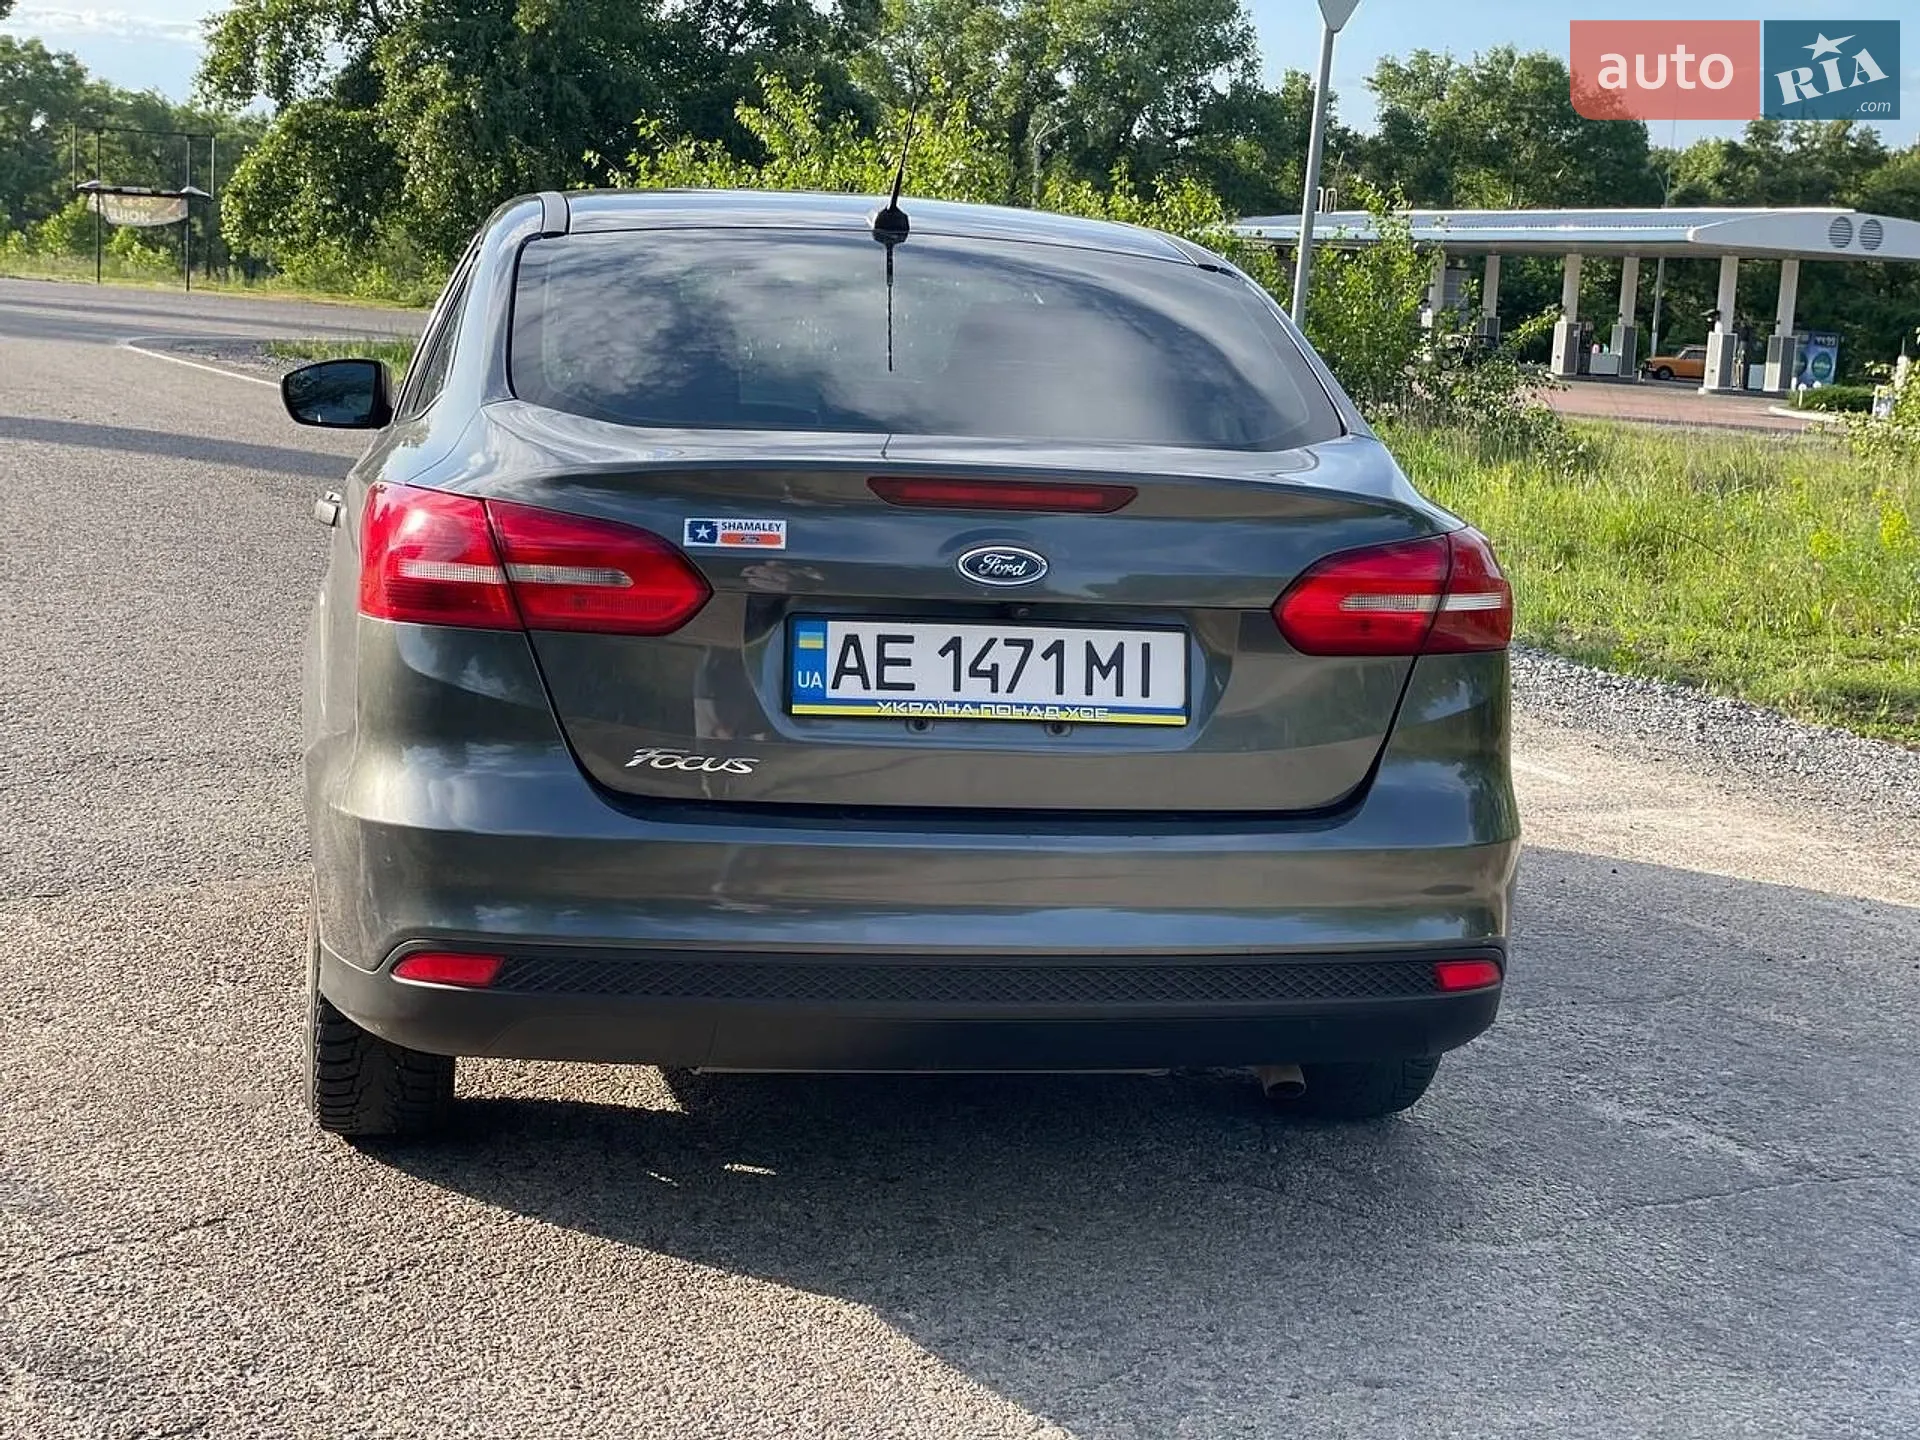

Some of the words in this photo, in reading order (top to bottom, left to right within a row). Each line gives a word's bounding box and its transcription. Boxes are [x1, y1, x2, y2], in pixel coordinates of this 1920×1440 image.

[721, 521, 782, 532] SHAMALEY
[978, 553, 1028, 576] Ford
[830, 633, 916, 692] AE
[937, 635, 1065, 697] 1471
[1084, 639, 1151, 699] MI
[797, 671, 823, 689] UA
[877, 700, 973, 716] УКРАЇНА
[980, 703, 1060, 719] ПОНАД
